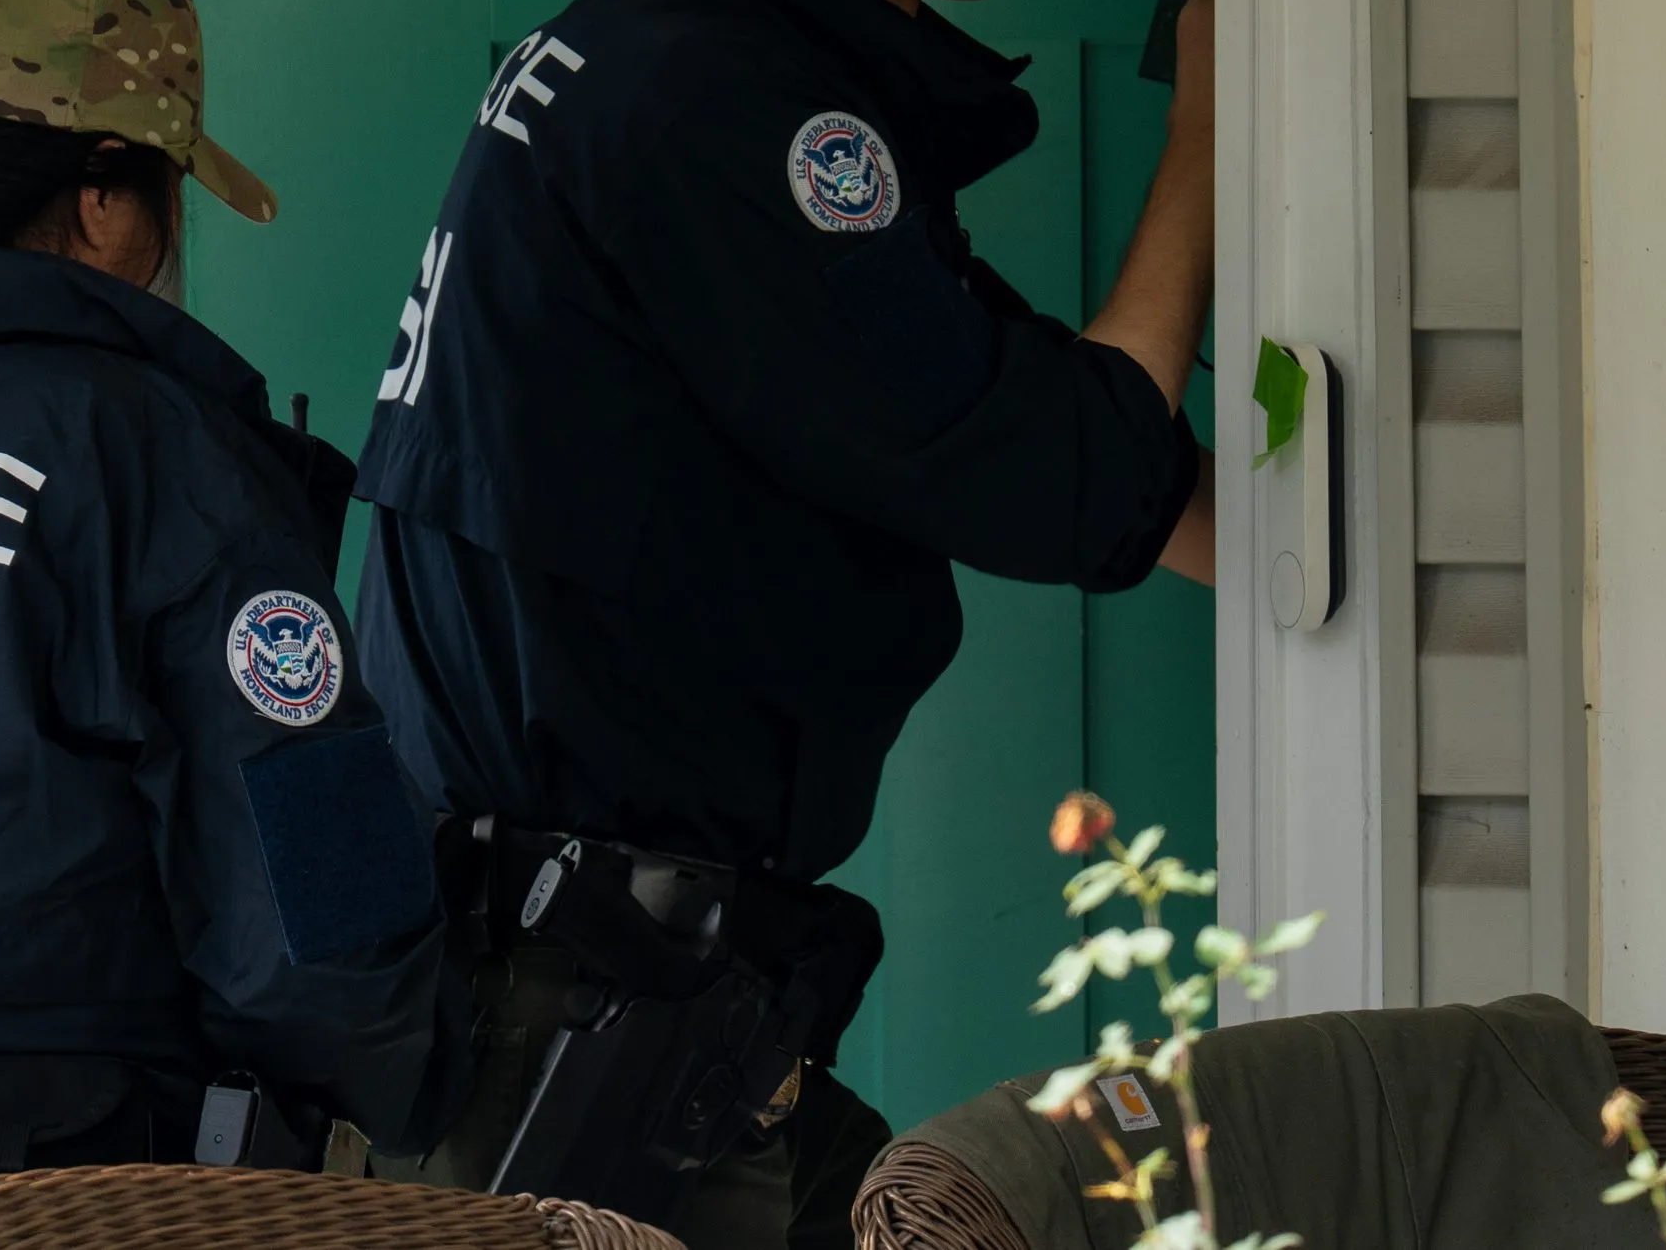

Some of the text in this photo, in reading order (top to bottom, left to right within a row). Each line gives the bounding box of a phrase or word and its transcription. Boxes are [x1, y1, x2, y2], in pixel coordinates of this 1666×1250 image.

[801, 118, 870, 150] DEPARTMENT
[869, 140, 883, 156] OF
[806, 171, 895, 232] HOMELAND SECURITY
[246, 595, 325, 627] DEPARTMENT
[321, 627, 334, 646] OF
[240, 660, 338, 720] HOMELAND SECURITY
